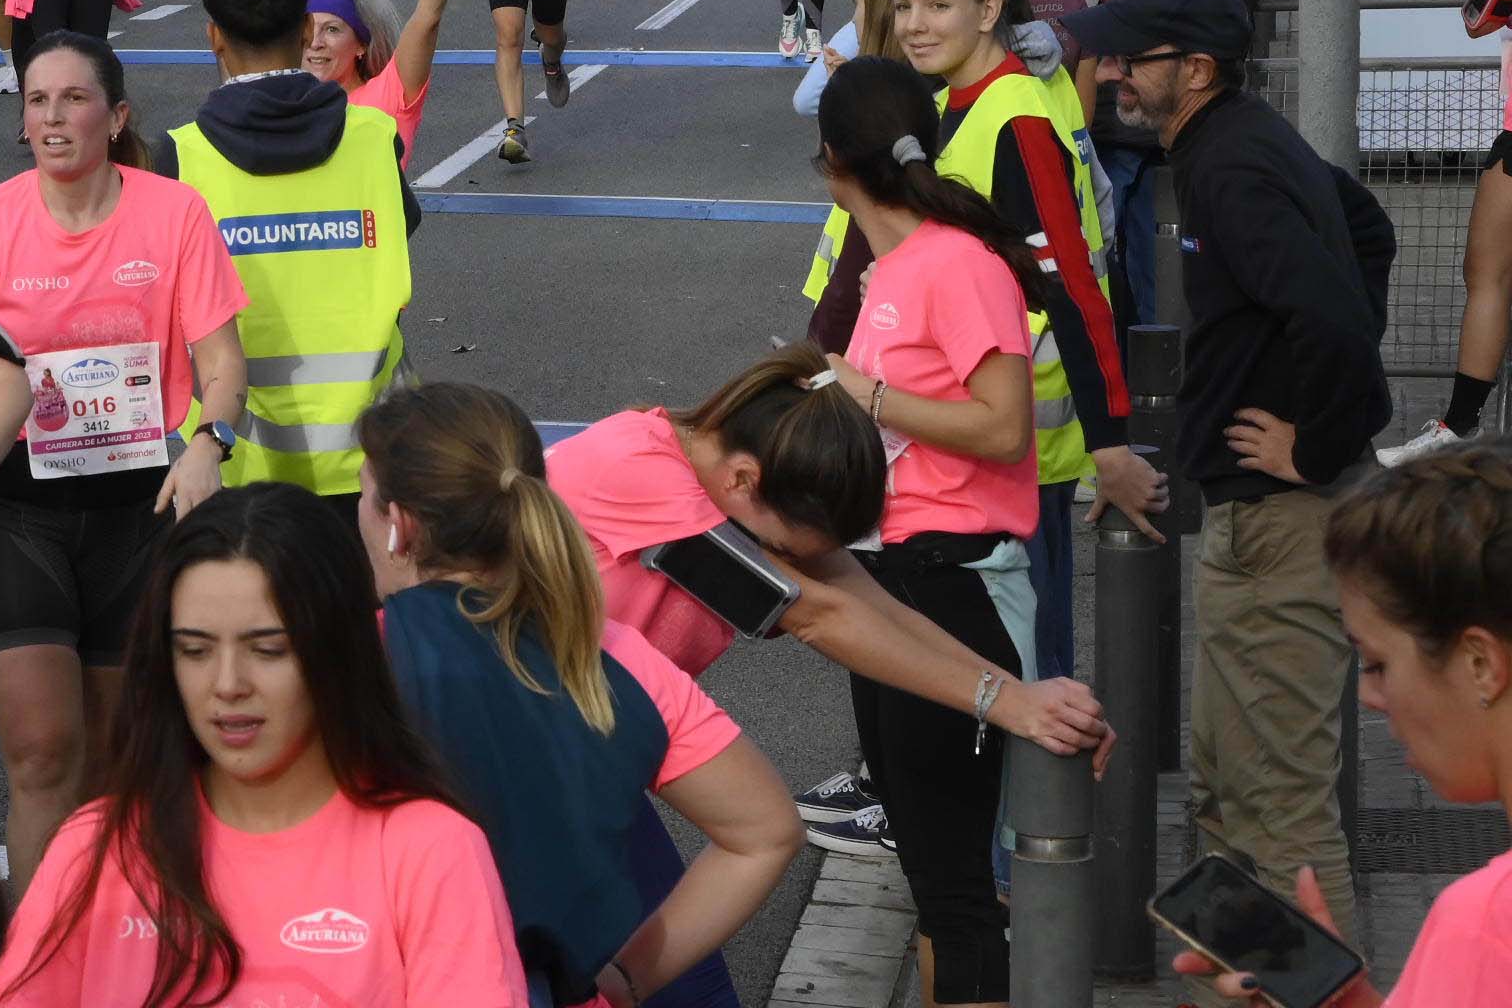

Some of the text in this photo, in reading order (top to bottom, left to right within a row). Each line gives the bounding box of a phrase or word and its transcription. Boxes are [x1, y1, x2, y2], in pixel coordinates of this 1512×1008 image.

[222, 220, 360, 246] VOLUNTARIS
[117, 269, 156, 282] ASTURIANA
[13, 276, 70, 291] OYSHO
[124, 360, 149, 368] SUMA
[66, 367, 116, 383] ASTURIANA
[73, 396, 117, 417] 016
[83, 420, 110, 432] 3412
[45, 441, 83, 451] CARRERA
[107, 434, 132, 442] MUJER
[134, 431, 151, 440] 2023
[117, 448, 156, 460] Santander
[44, 457, 86, 469] OYSHO
[289, 925, 367, 944] ASTURIANA
